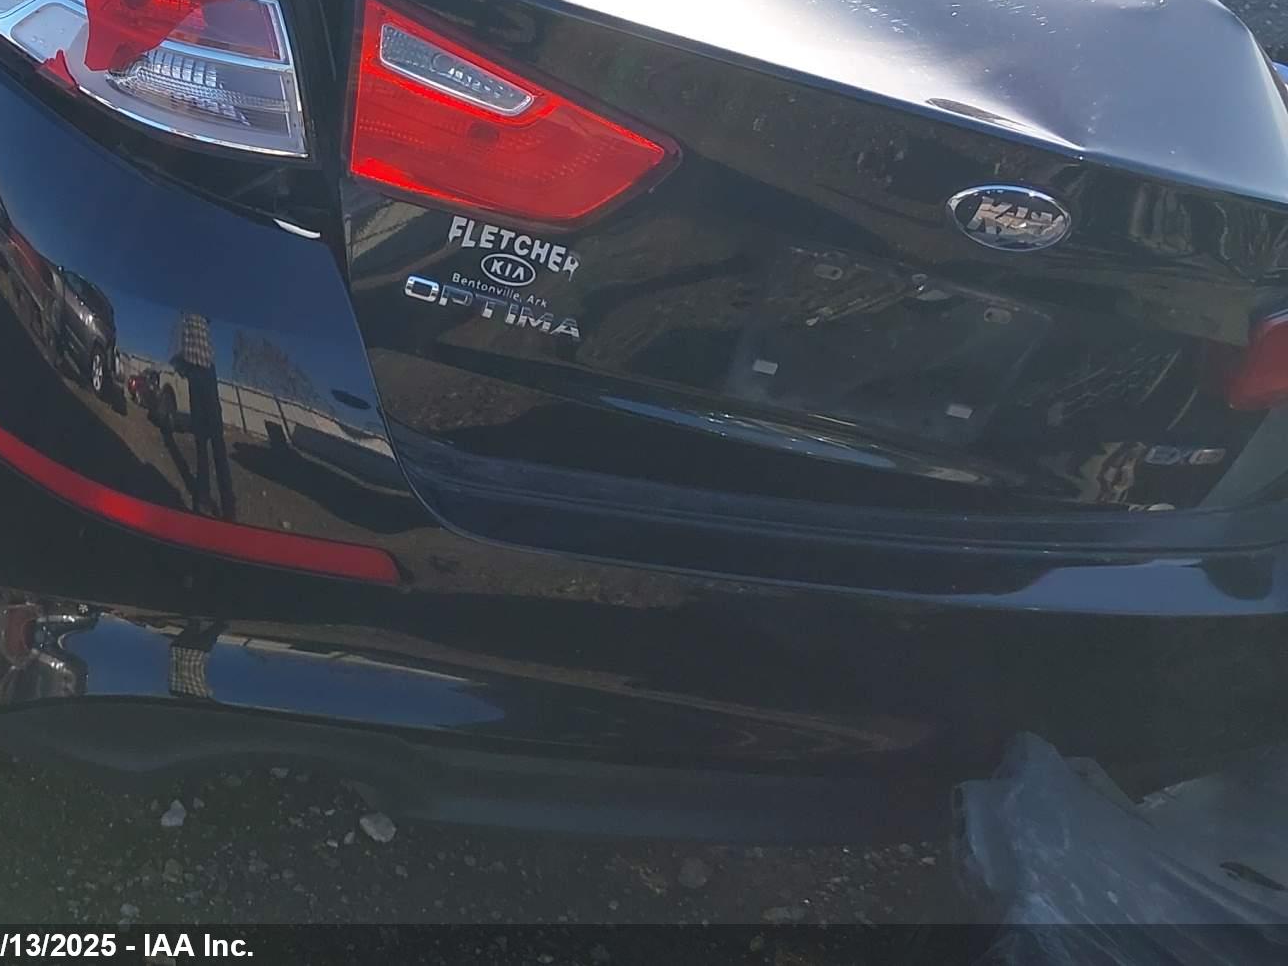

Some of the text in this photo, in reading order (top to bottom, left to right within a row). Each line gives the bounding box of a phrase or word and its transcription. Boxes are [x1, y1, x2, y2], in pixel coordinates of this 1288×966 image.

[448, 215, 580, 282] FLETCHER
[490, 258, 525, 281] KIA
[404, 275, 580, 339] OPTIMA
[452, 272, 548, 308] Bentonville, Ark
